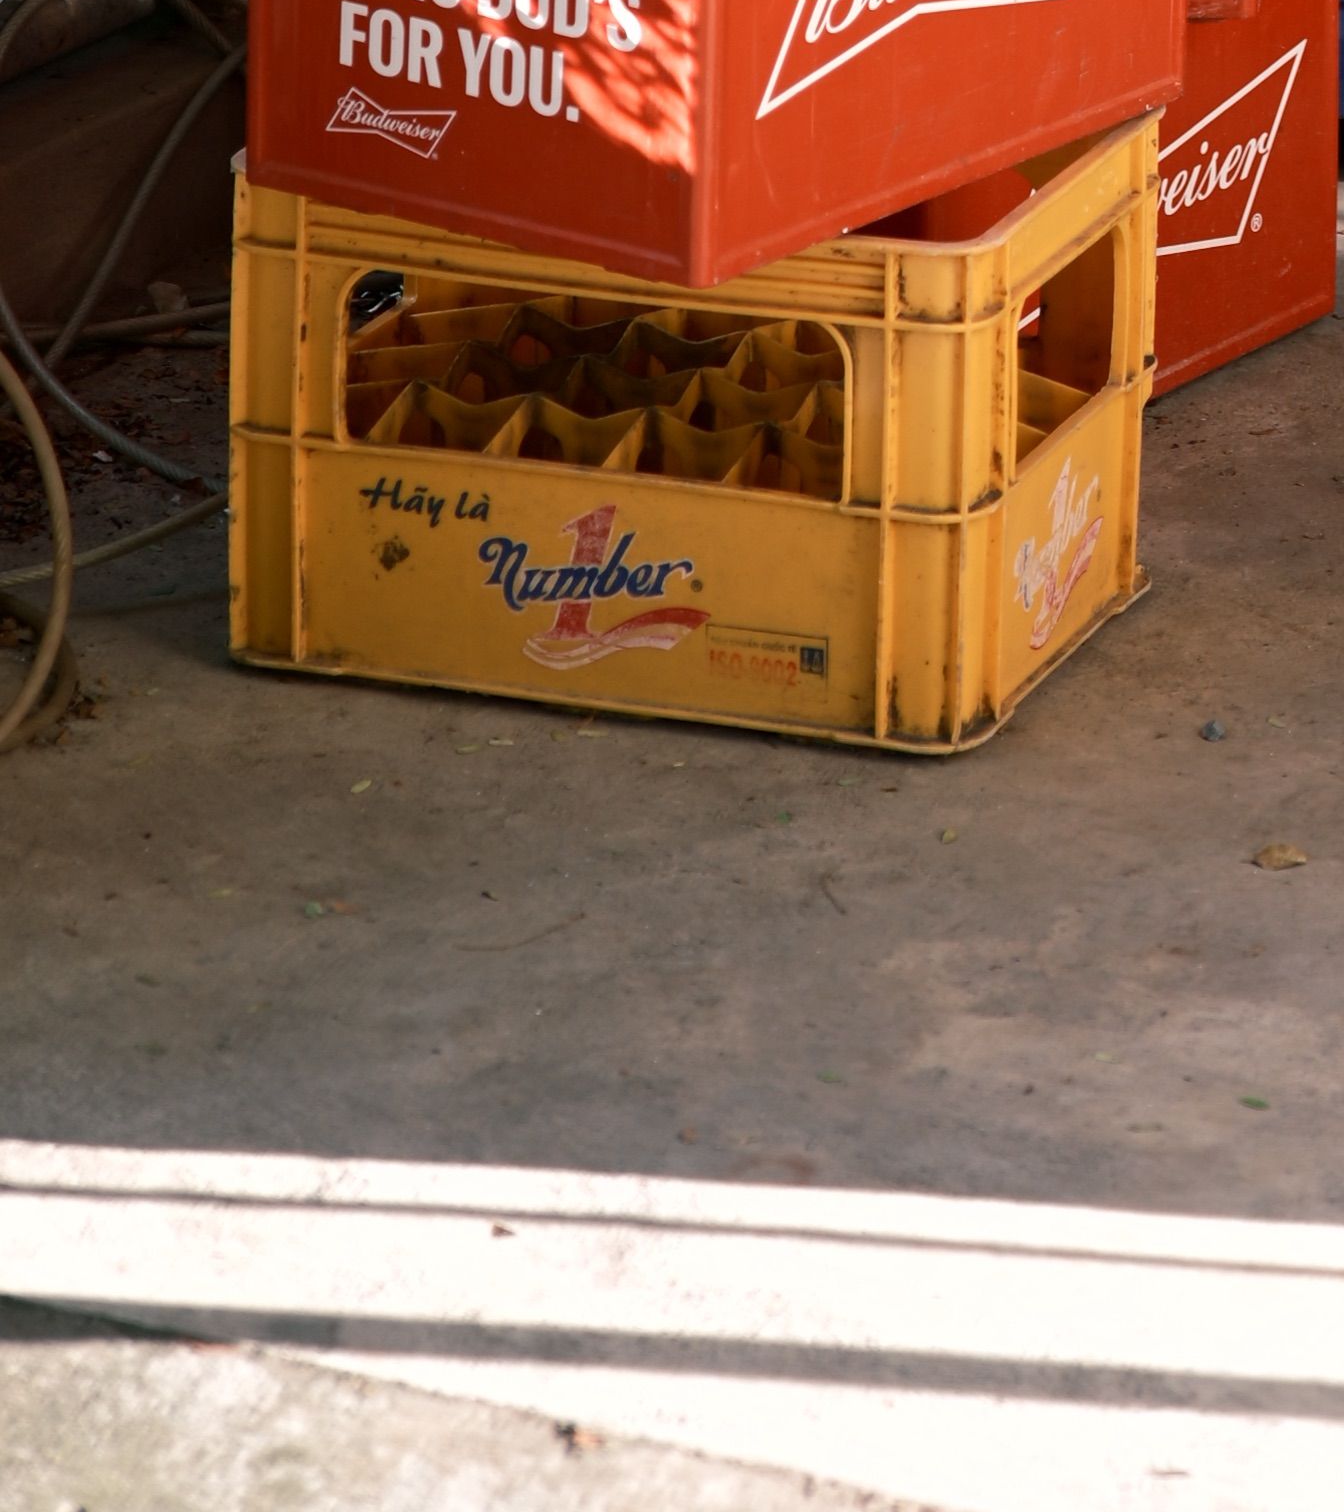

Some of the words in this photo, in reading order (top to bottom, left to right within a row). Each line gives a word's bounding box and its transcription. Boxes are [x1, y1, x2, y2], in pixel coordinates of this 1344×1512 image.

[338, 0, 443, 89] FOR
[456, 28, 580, 124] YOU.
[337, 96, 443, 143] Budweiser
[359, 476, 447, 529] Hãy
[454, 488, 493, 523] là
[478, 530, 696, 613] Number
